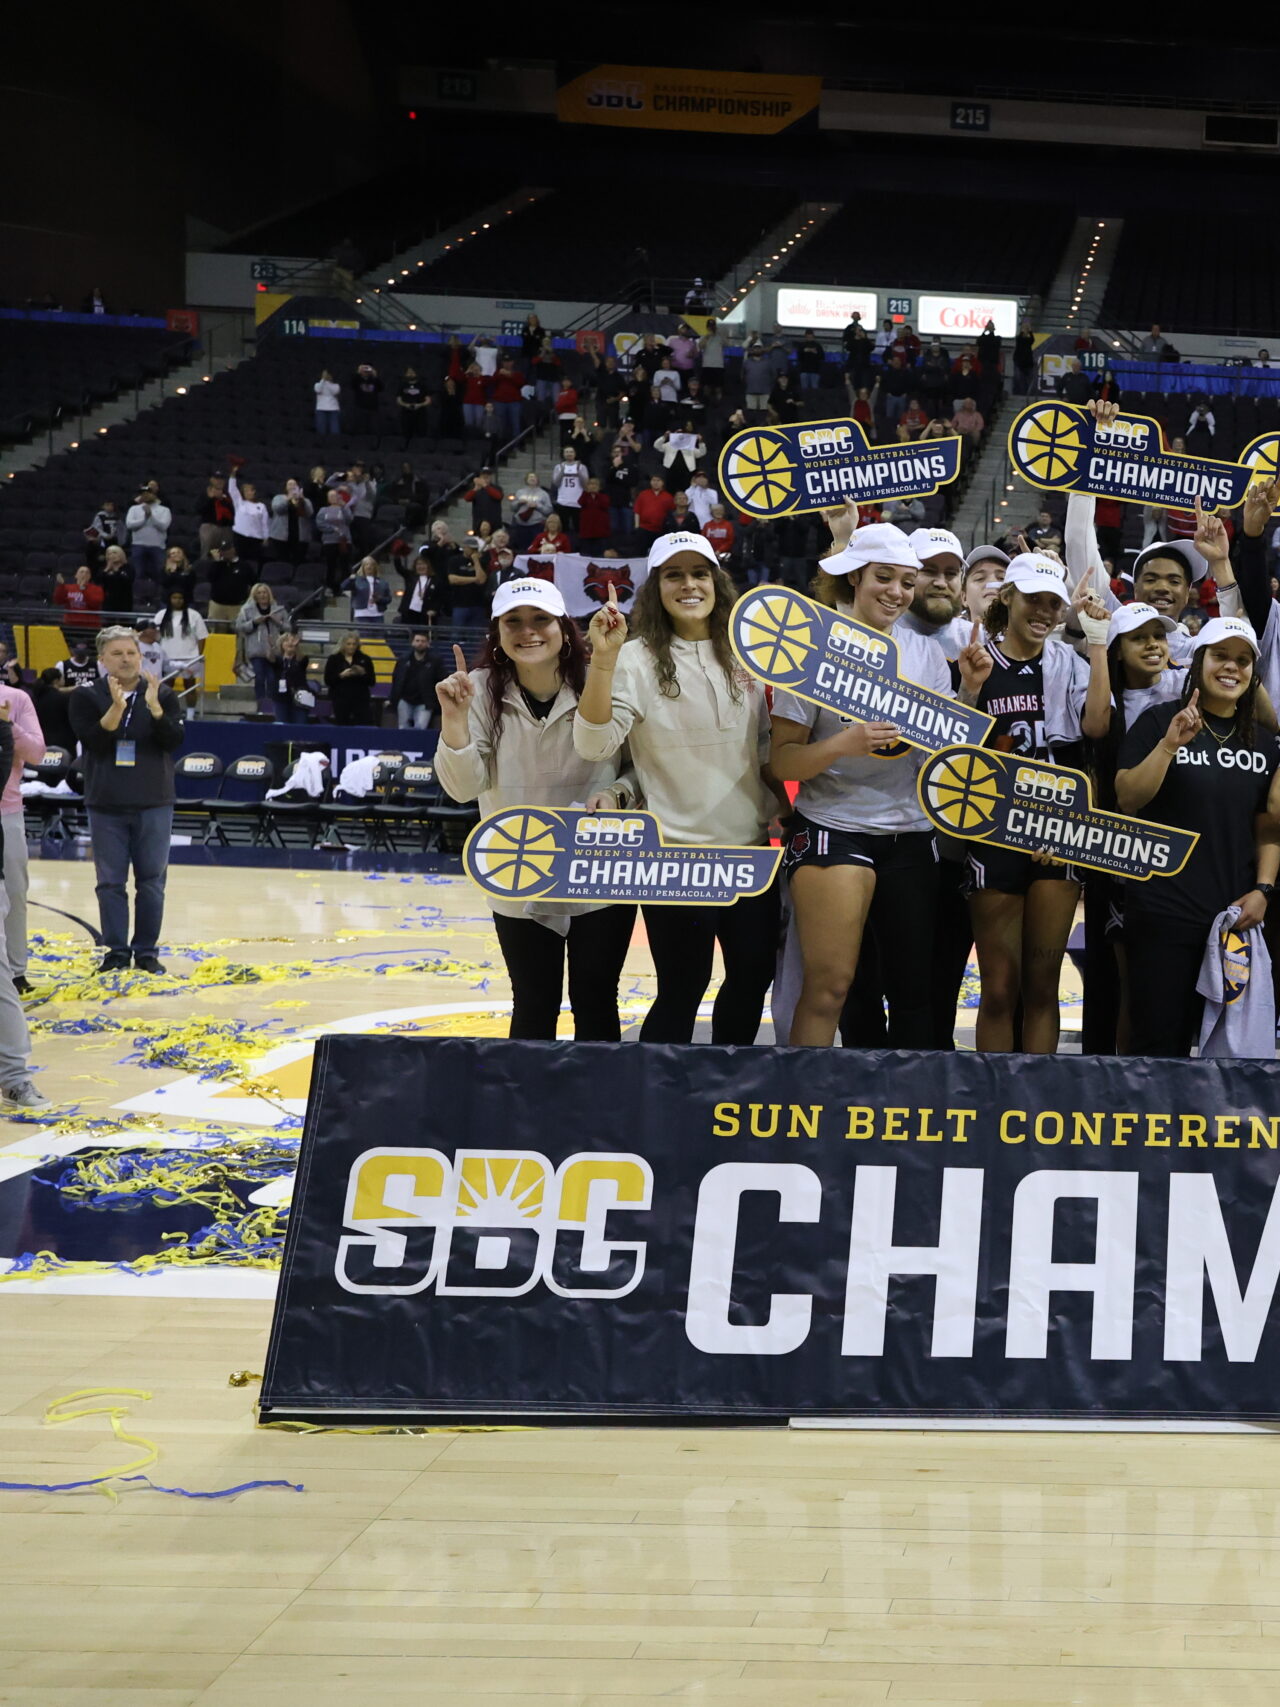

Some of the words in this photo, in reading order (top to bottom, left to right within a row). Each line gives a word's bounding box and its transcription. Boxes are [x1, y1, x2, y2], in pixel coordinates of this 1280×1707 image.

[586, 79, 644, 110] SBC
[653, 95, 791, 117] CHAMPIONSHIP
[955, 109, 986, 125] 215
[890, 300, 909, 313] 215
[939, 307, 994, 329] Coke
[284, 320, 306, 334] 114
[1083, 353, 1105, 367] 116
[798, 426, 853, 458] SBC
[1094, 420, 1149, 451] SBC
[804, 457, 850, 468] WOMEN'S
[854, 449, 916, 463] BASKETBALL
[1093, 447, 1140, 460] WOMEN'S
[1144, 456, 1207, 471] BASKETBALL
[564, 479, 575, 487] 15
[805, 455, 946, 494] CHAMPIONS
[1088, 482, 1106, 491] MAR.
[1121, 488, 1140, 496] MAR.
[1089, 457, 1233, 501] CHAMPIONS
[810, 496, 830, 505] MAR.
[876, 485, 920, 496] PENSACOLA,
[827, 621, 888, 670] SBC
[825, 651, 874, 678] WOMEN'S
[878, 674, 945, 710] BASKETBALL
[813, 688, 833, 702] MAR.
[848, 704, 869, 718] MAR.
[871, 714, 880, 722] 10
[816, 662, 969, 744] CHAMPIONS
[987, 695, 1038, 715] ARKANSAS
[1176, 746, 1210, 765] But
[1217, 748, 1269, 775] GOD.
[1014, 766, 1077, 806] SBC
[1013, 798, 1064, 816] WOMEN'S
[1069, 811, 1141, 835] BASKETBALL
[575, 817, 645, 847] SBC
[1006, 808, 1170, 868] CHAMPIONS
[574, 849, 633, 857] WOMEN'S
[639, 850, 721, 860] BASKETBALL
[1004, 835, 1026, 845] MAR.
[1080, 852, 1132, 871] PENSACOLA,
[1134, 865, 1144, 873] FL
[568, 859, 755, 888] CHAMPIONS
[656, 890, 714, 898] PENSACOLA,
[712, 1102, 819, 1138] SUN
[847, 1107, 977, 1142] BELT
[334, 1147, 654, 1299] SBC
